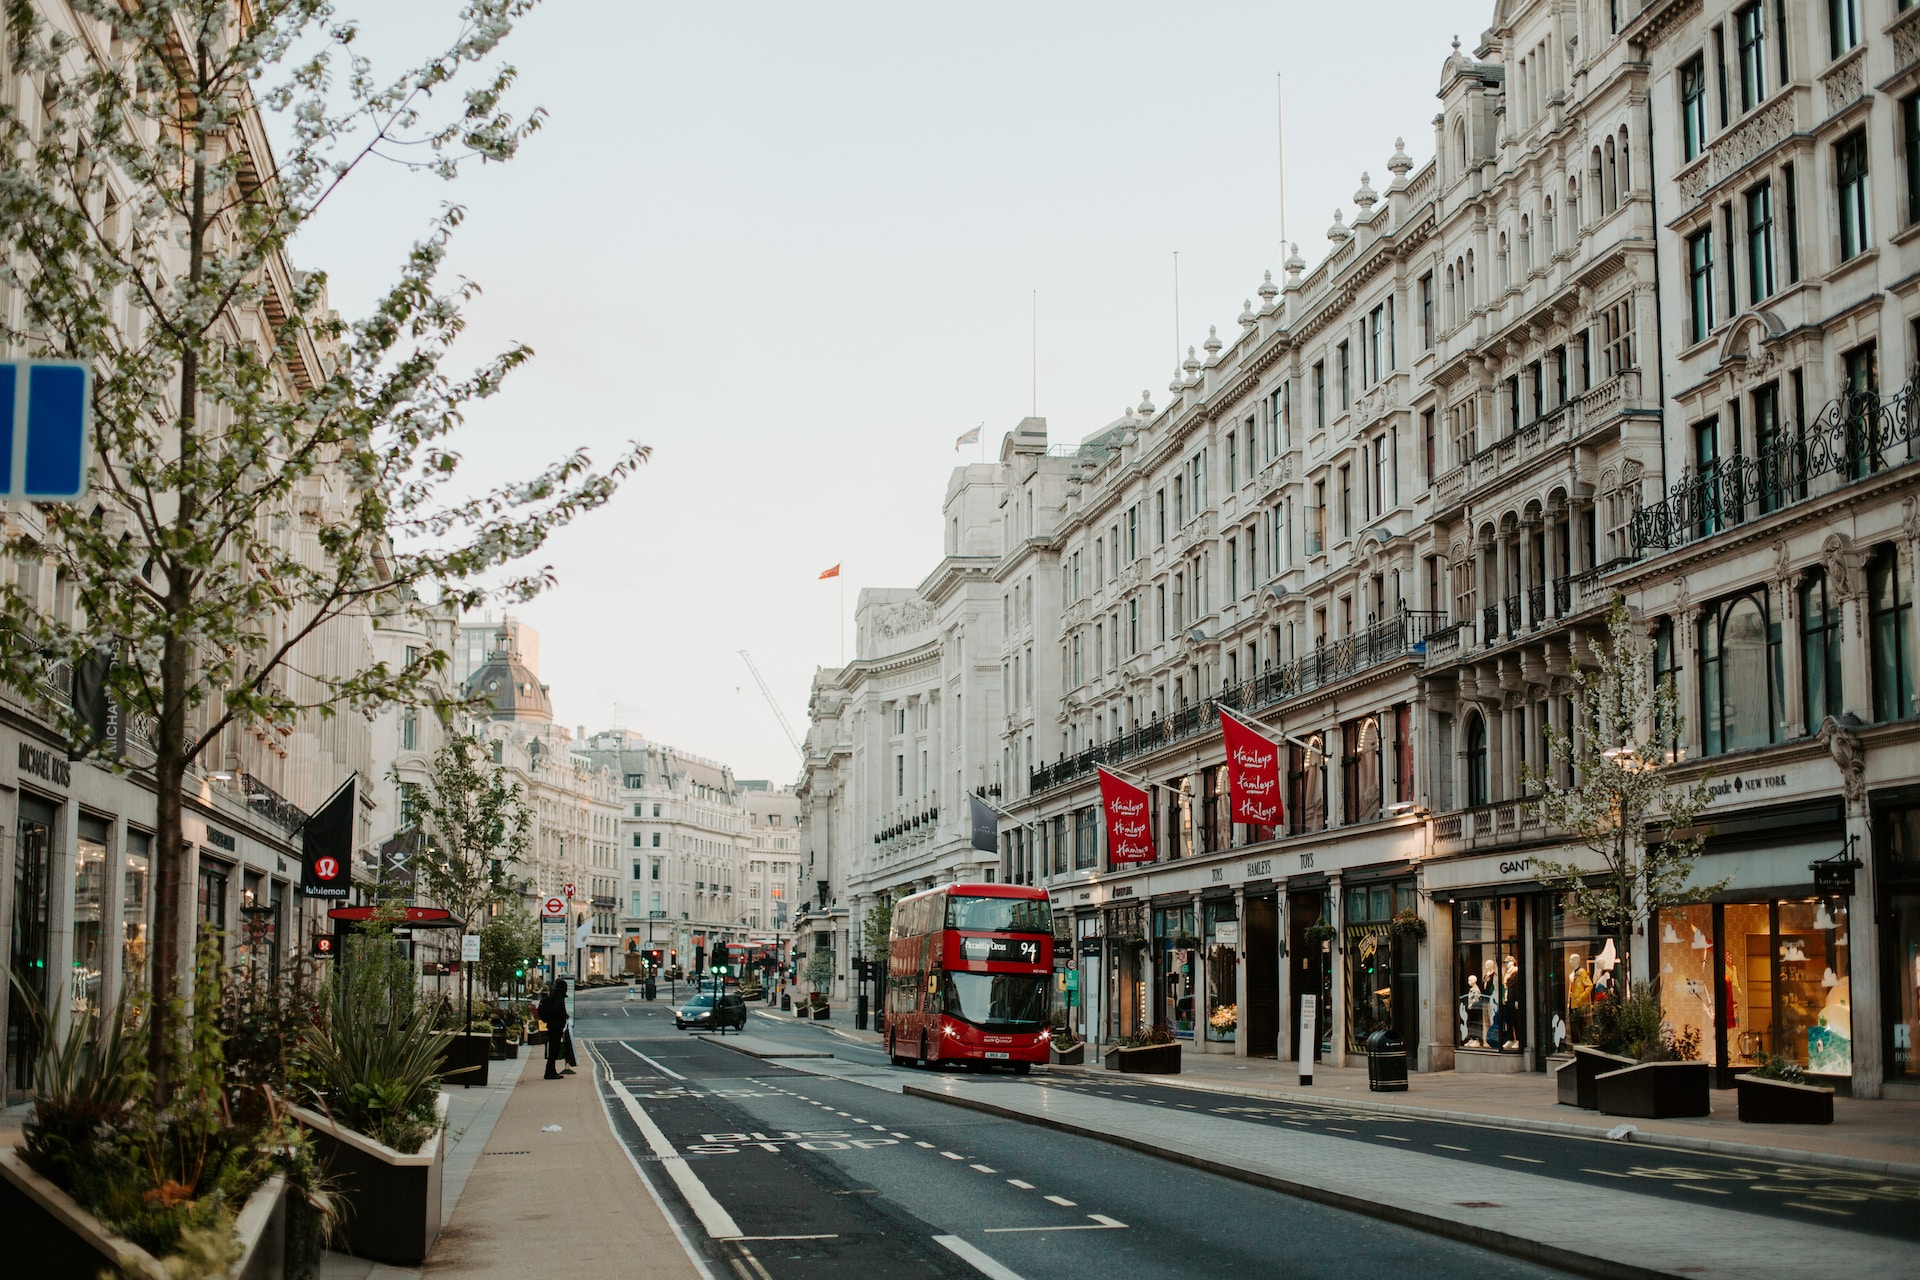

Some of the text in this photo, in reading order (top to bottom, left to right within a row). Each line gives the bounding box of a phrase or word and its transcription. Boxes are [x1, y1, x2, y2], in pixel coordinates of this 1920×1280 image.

[1233, 745, 1272, 769] Hamleys
[19, 742, 71, 788] MICHAEL KORS
[1708, 779, 1732, 801] spade
[1744, 780, 1762, 791] NEW
[1764, 774, 1787, 788] YORK
[1110, 796, 1144, 816] Hamleys
[1212, 853, 1314, 882] TOYS HAMLEYS TOYS
[1500, 859, 1530, 874] GANT
[306, 886, 346, 895] lululemon
[965, 940, 1007, 952] Piccadilly Circus
[1020, 942, 1036, 955] 94
[1895, 1051, 1912, 1063] BOSS
[700, 1131, 852, 1142] BUS
[686, 1139, 900, 1154] STOP
